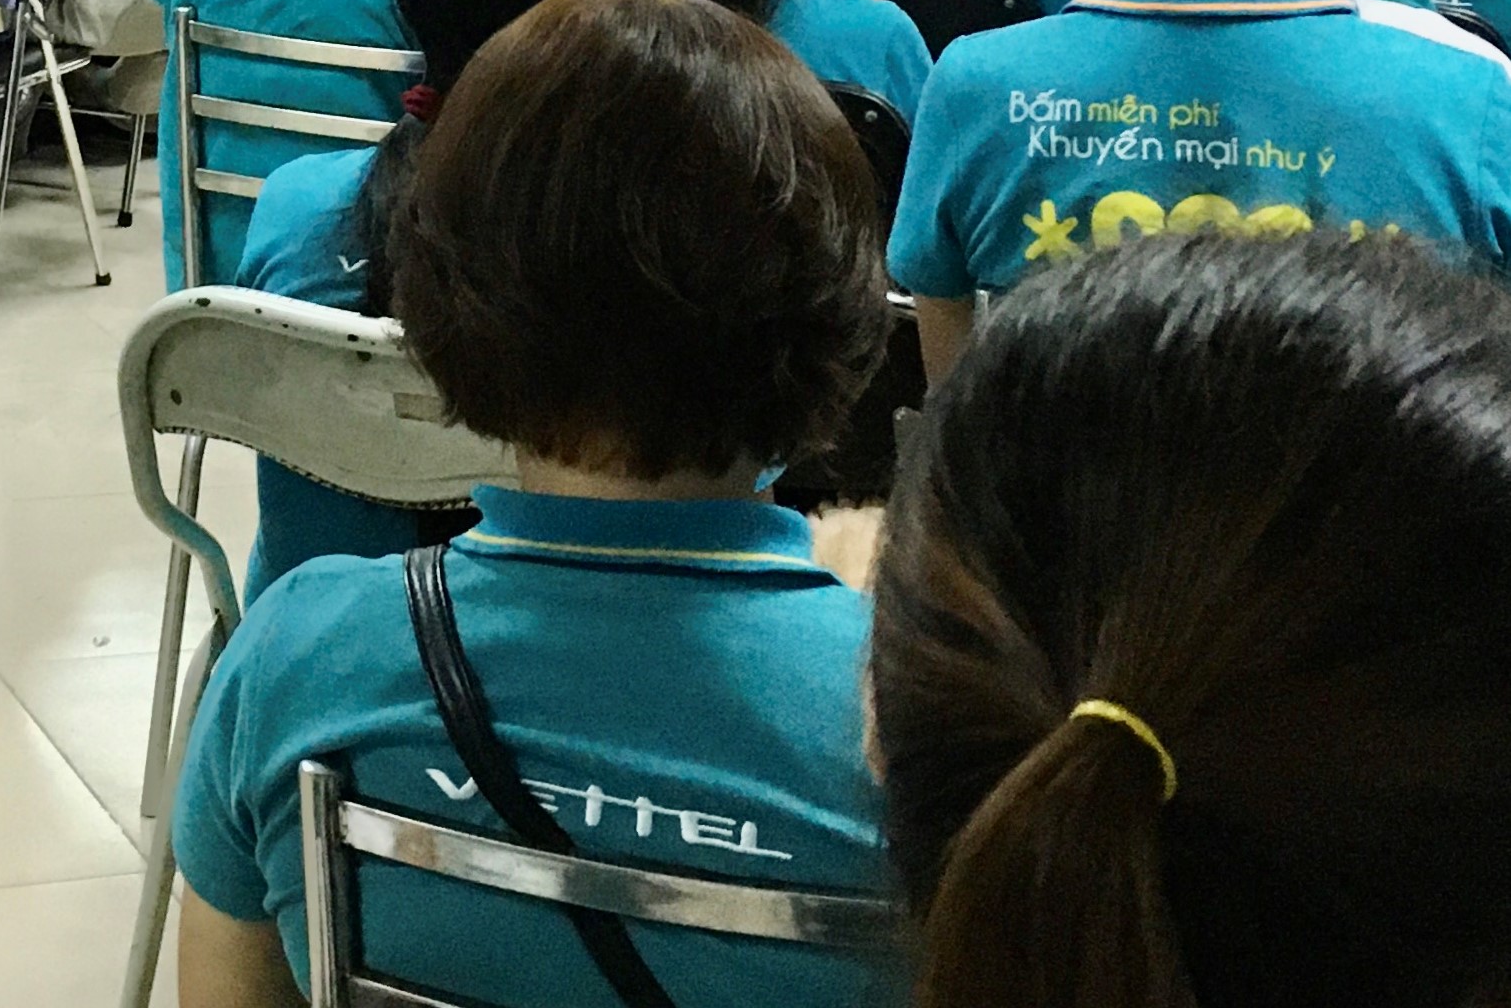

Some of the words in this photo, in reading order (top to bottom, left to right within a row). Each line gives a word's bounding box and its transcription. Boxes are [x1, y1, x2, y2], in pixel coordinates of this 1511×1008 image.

[1009, 88, 1081, 123] Bấm
[1087, 93, 1158, 125] miễn
[1028, 125, 1163, 166] Khuyến
[1175, 137, 1238, 170] mại
[1245, 138, 1307, 172] như
[1317, 147, 1336, 177] ý
